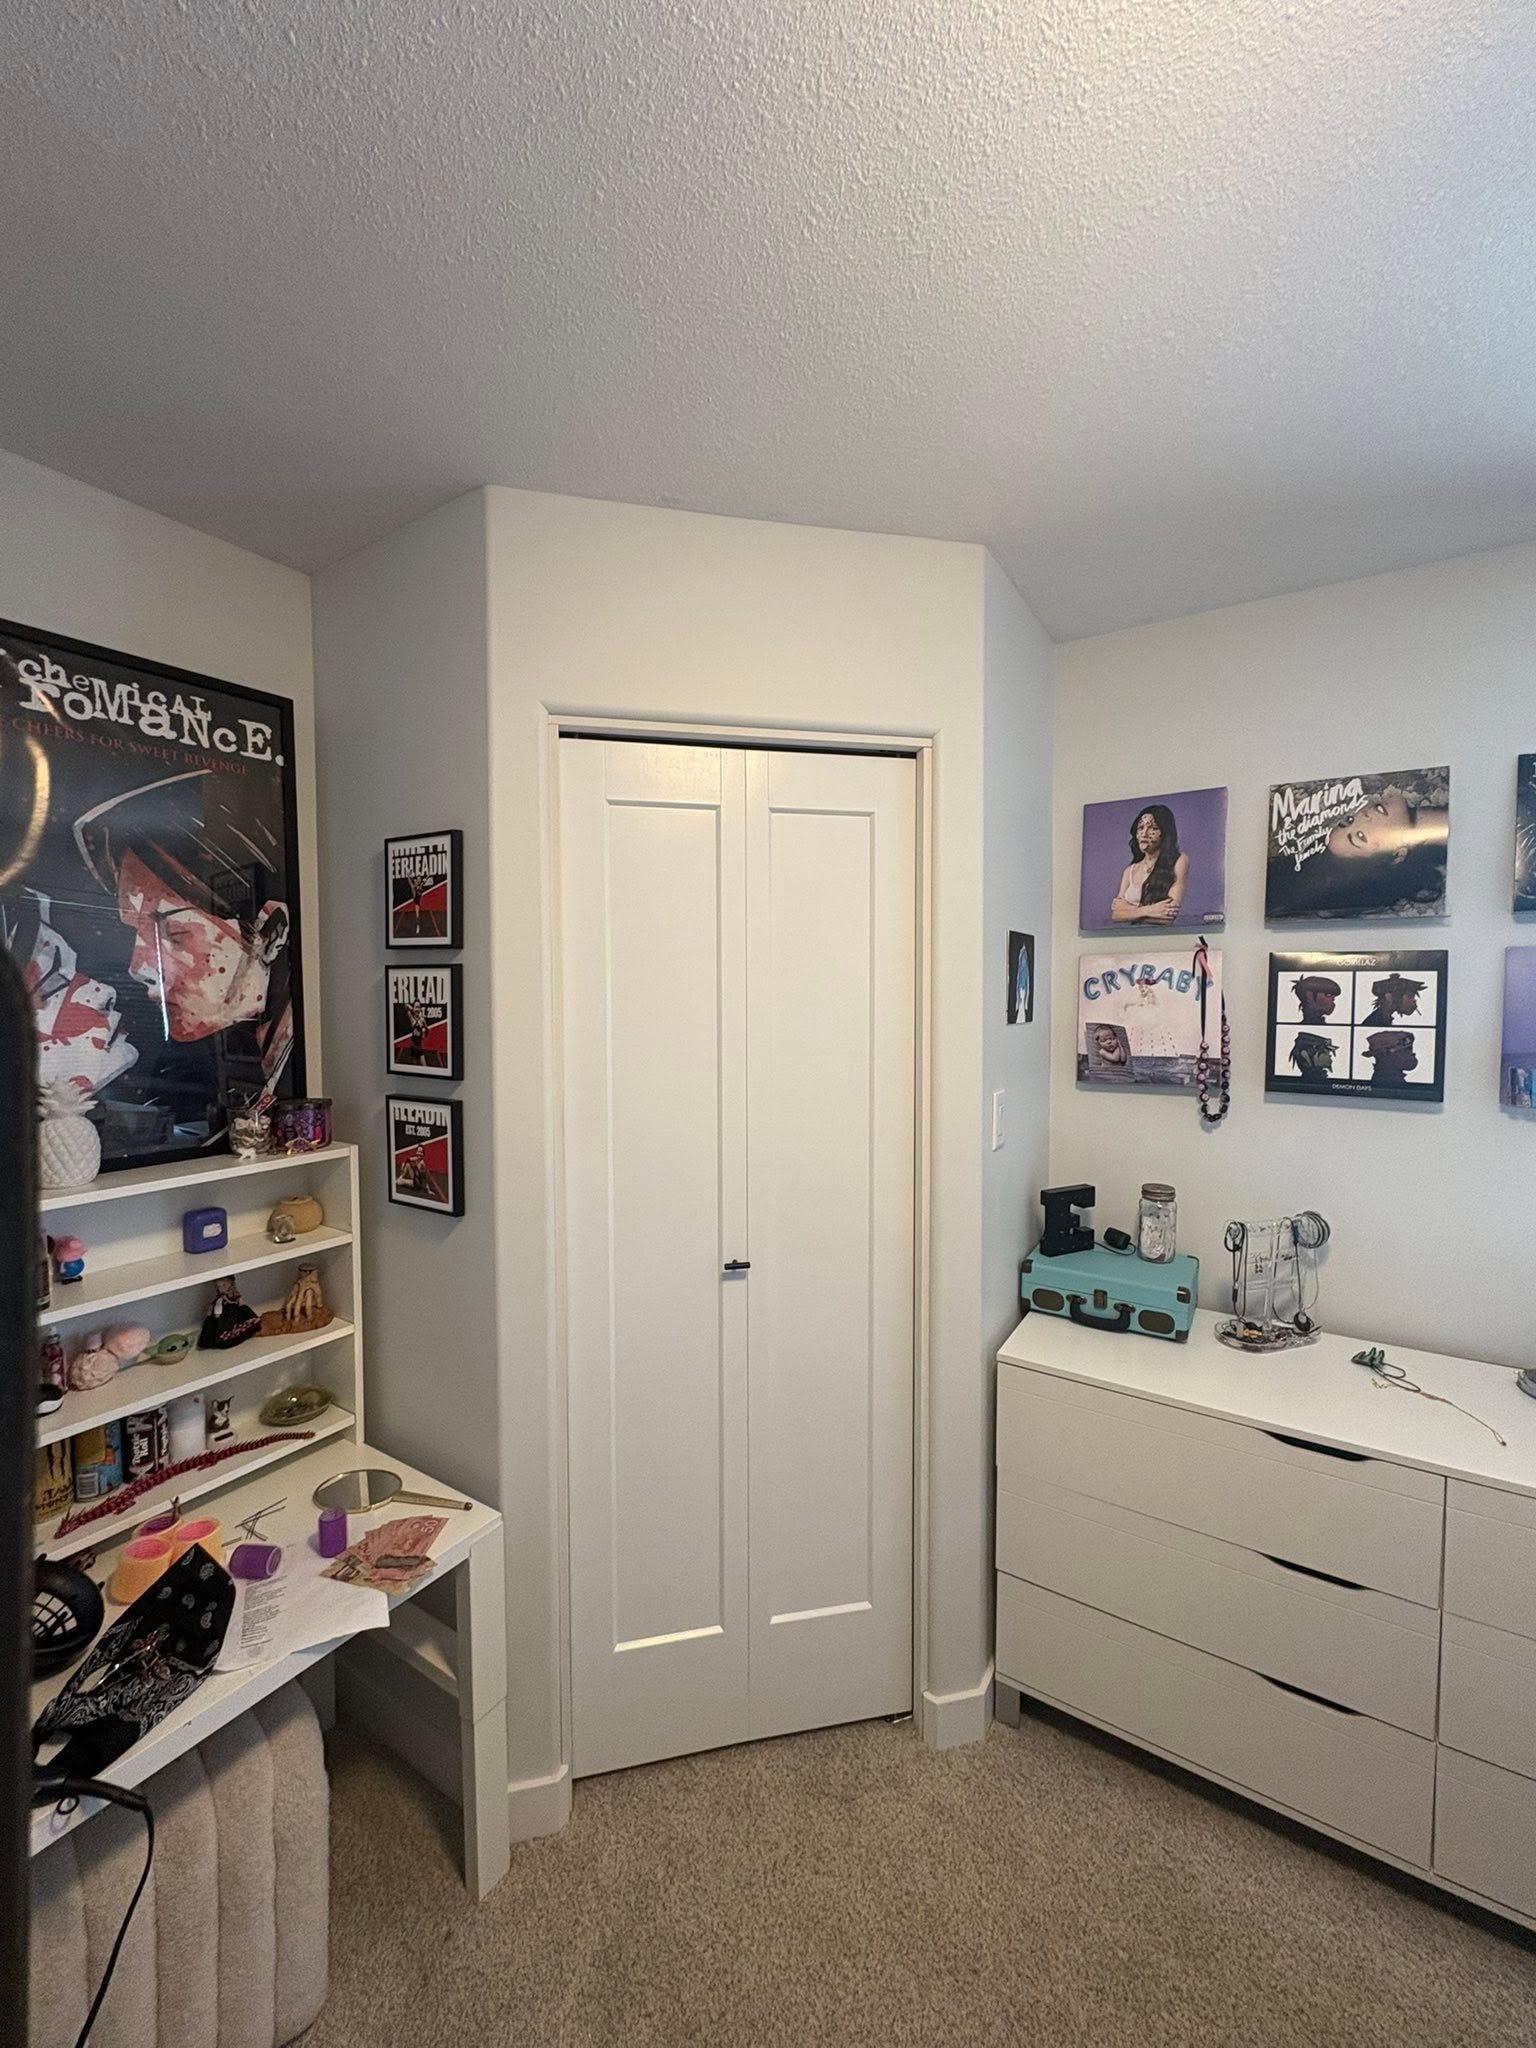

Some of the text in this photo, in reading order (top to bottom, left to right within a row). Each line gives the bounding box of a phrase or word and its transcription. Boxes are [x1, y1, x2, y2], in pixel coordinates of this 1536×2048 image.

[12, 718, 84, 742] CHEERS
[91, 733, 123, 750] FOR
[128, 741, 177, 761] SWEET
[184, 752, 247, 776] REVENGE
[1272, 778, 1364, 832] Marina
[1275, 794, 1368, 846] the diamonds
[1278, 845, 1297, 856] The
[405, 1124, 431, 1137] EST. 2005
[132, 1432, 141, 1466] Tootsie
[140, 1437, 149, 1456] Roll
